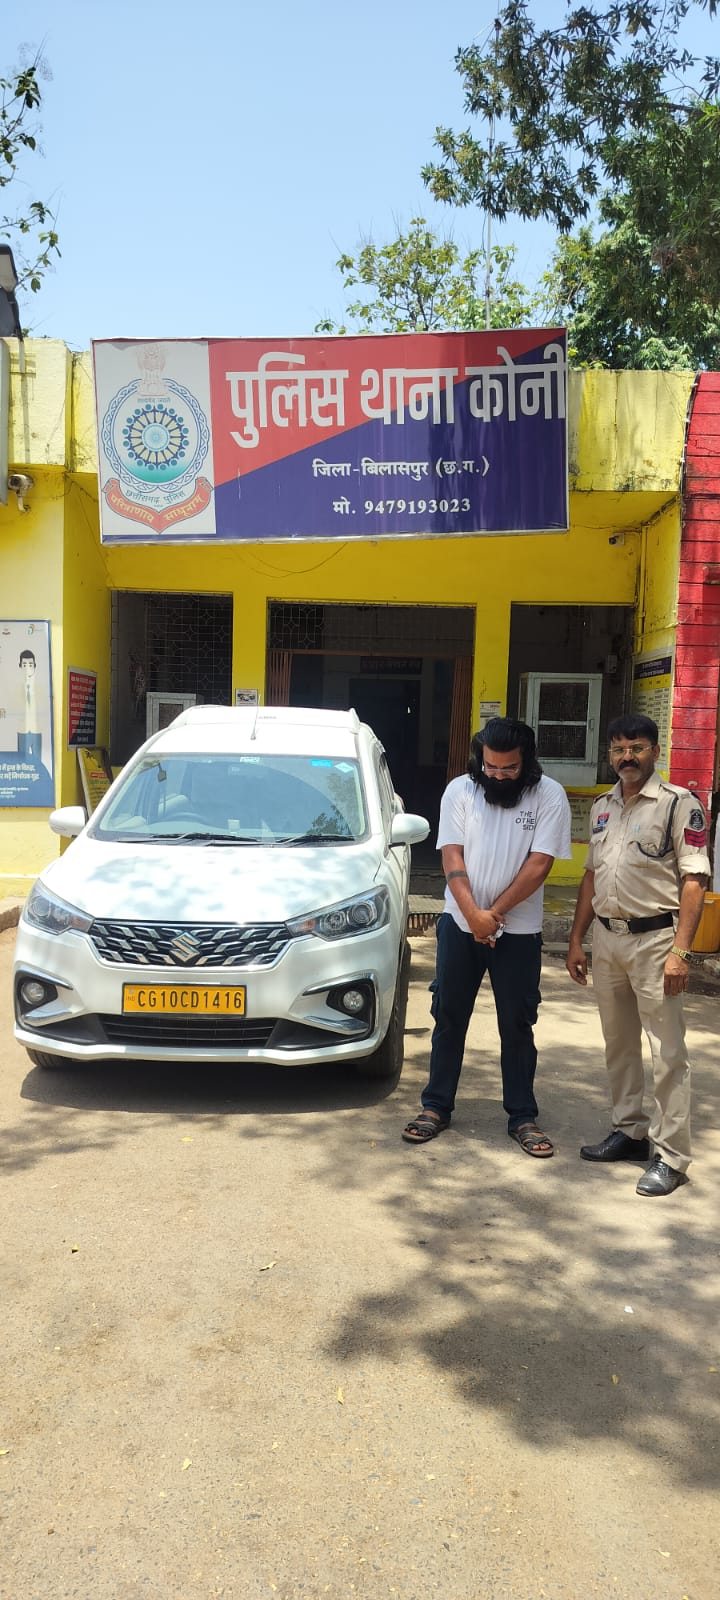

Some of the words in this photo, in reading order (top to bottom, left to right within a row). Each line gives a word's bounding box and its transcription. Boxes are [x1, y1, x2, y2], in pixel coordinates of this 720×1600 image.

[226, 352, 349, 448] पुलिस
[360, 367, 458, 425] थाना
[465, 343, 566, 422] कोनी
[435, 456, 490, 478] (छ.ग.)
[163, 490, 185, 504] पुलिस
[333, 496, 356, 514] मो.
[364, 498, 471, 514] 9479193023
[137, 990, 242, 1010] CG10CD1416
